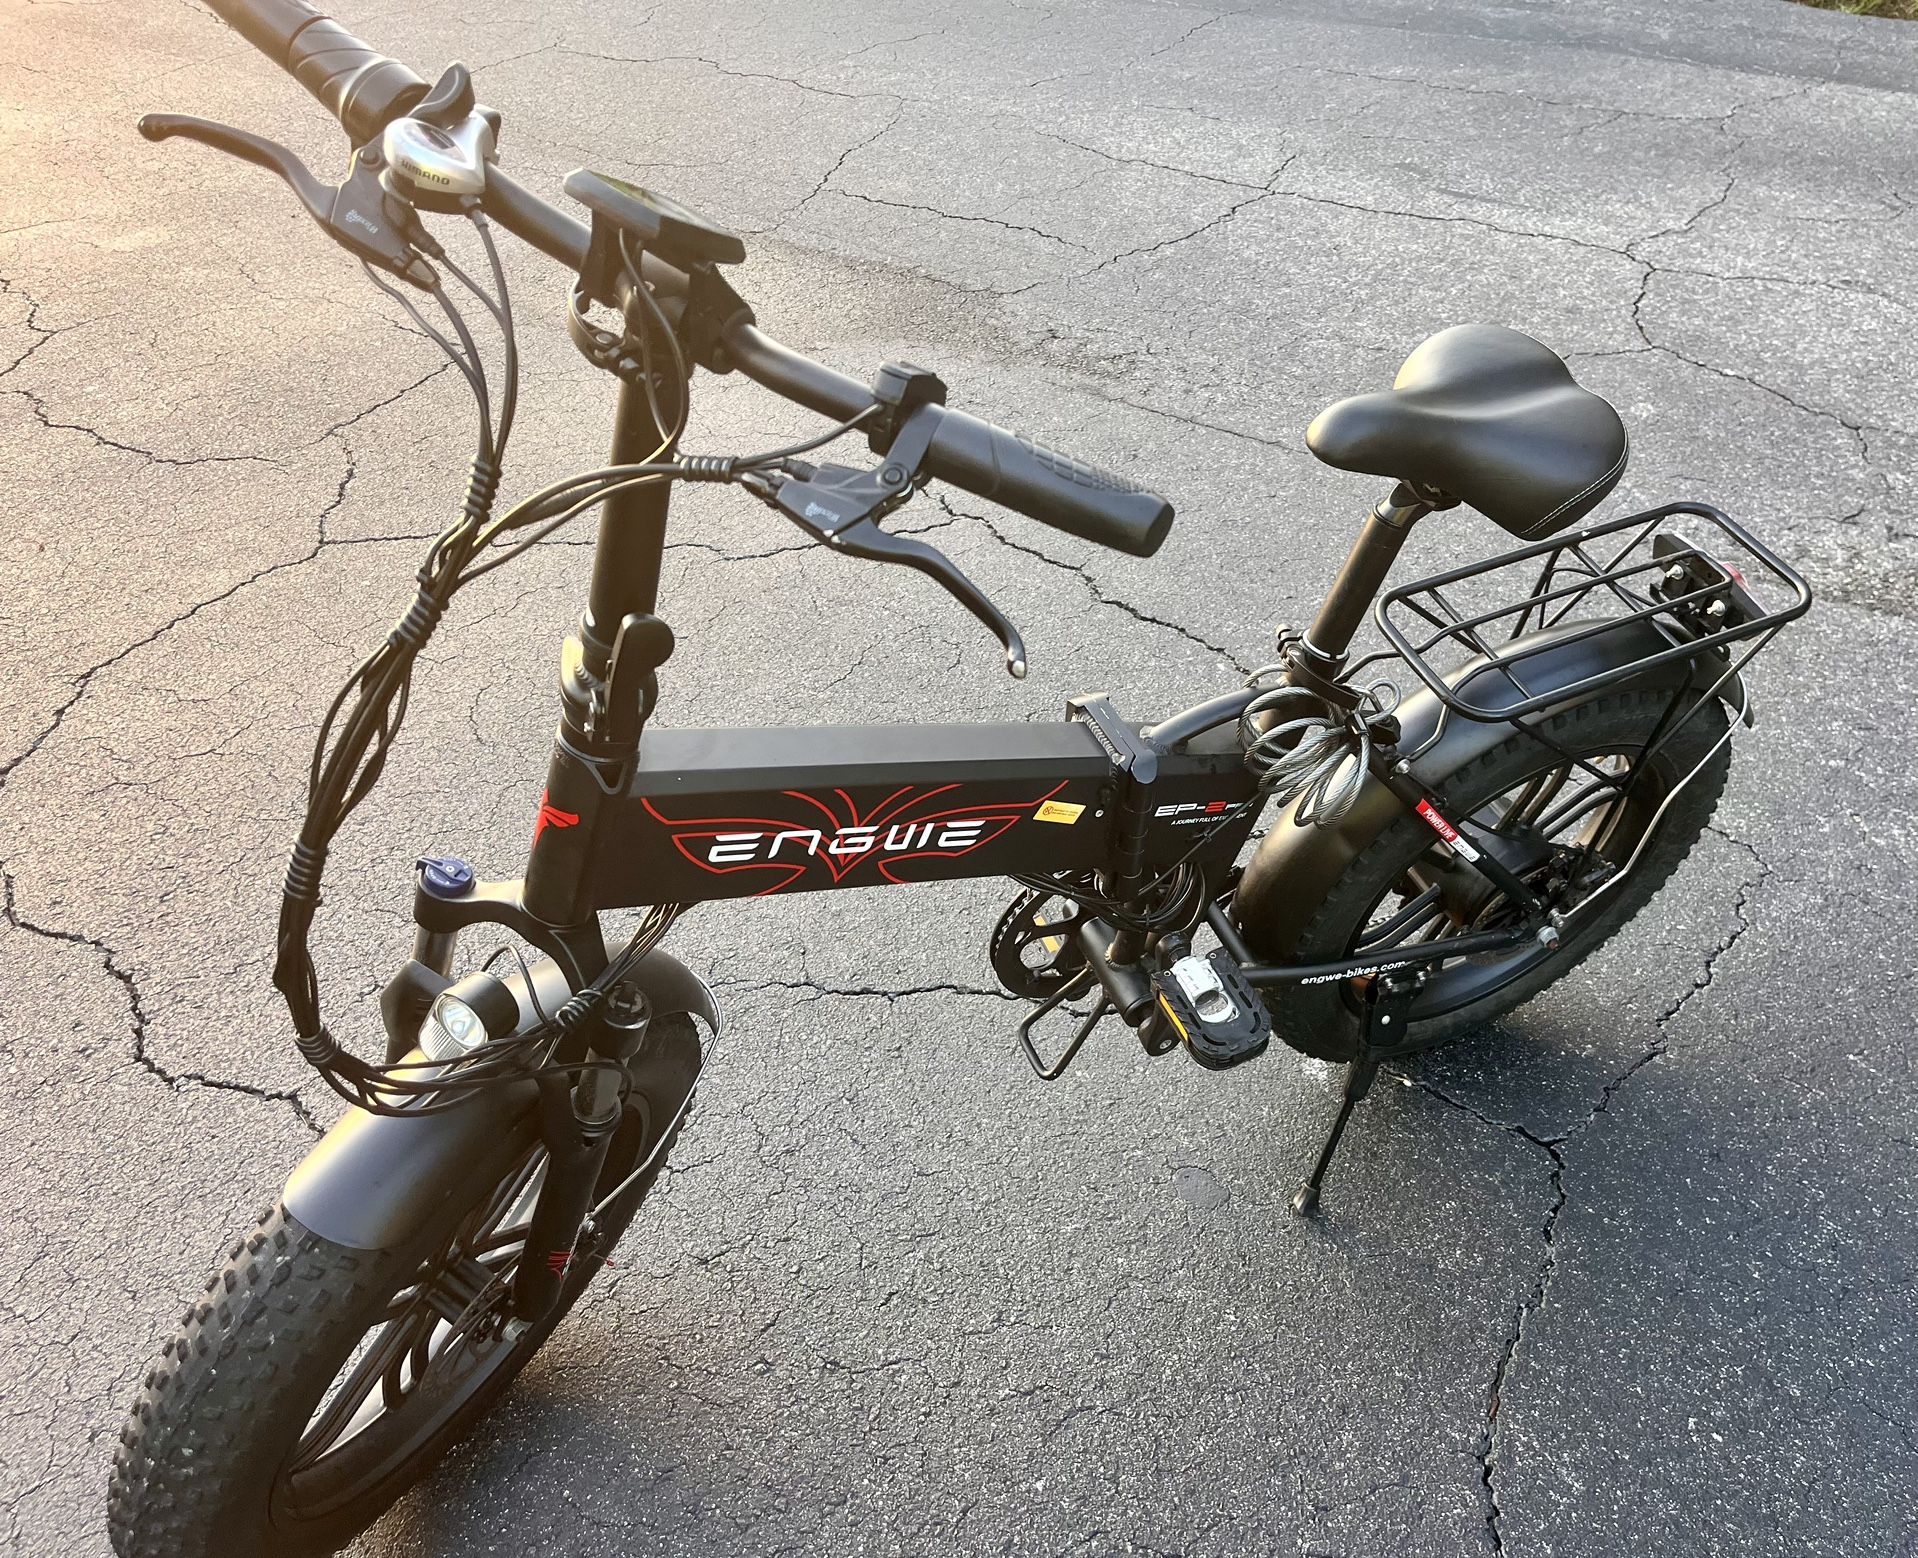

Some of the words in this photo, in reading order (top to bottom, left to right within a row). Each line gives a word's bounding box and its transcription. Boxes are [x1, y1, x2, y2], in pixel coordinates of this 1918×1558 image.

[401, 159, 451, 186] HIMANO
[1154, 801, 1227, 817] EP-2
[1300, 961, 1406, 985] engwe-bikes.com
